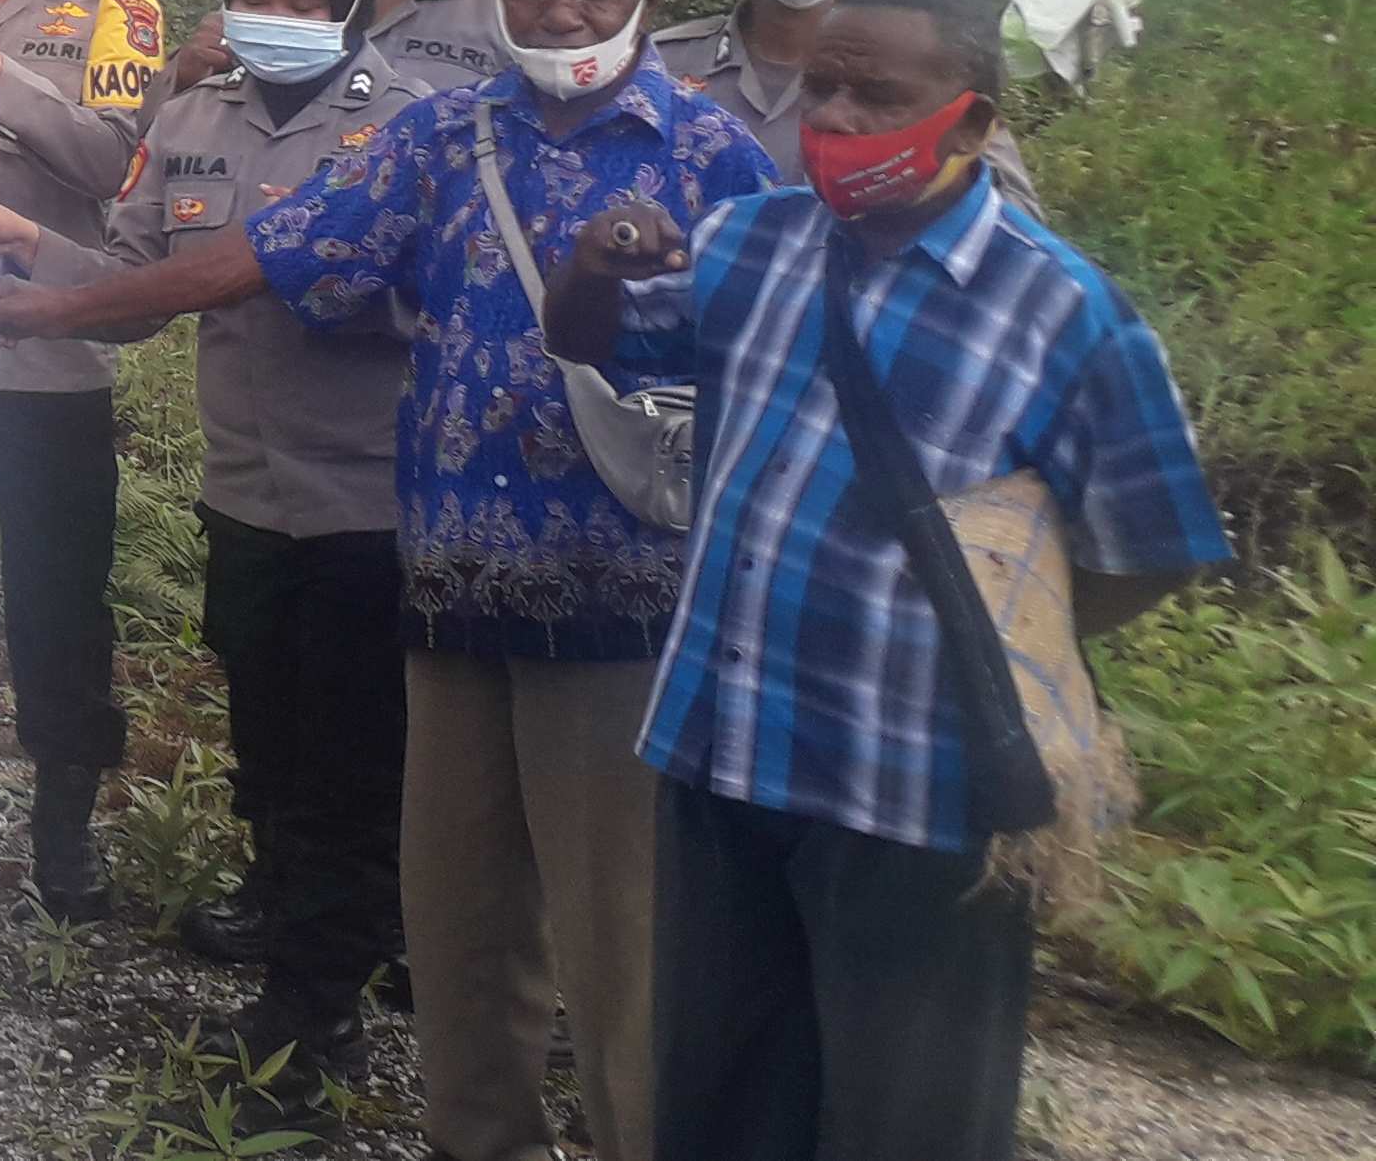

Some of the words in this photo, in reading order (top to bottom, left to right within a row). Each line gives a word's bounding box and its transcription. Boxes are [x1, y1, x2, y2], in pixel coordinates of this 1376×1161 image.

[22, 42, 83, 60] POLRI
[406, 39, 488, 67] POLRI
[89, 61, 160, 100] KAOP
[164, 156, 227, 177] MILA
